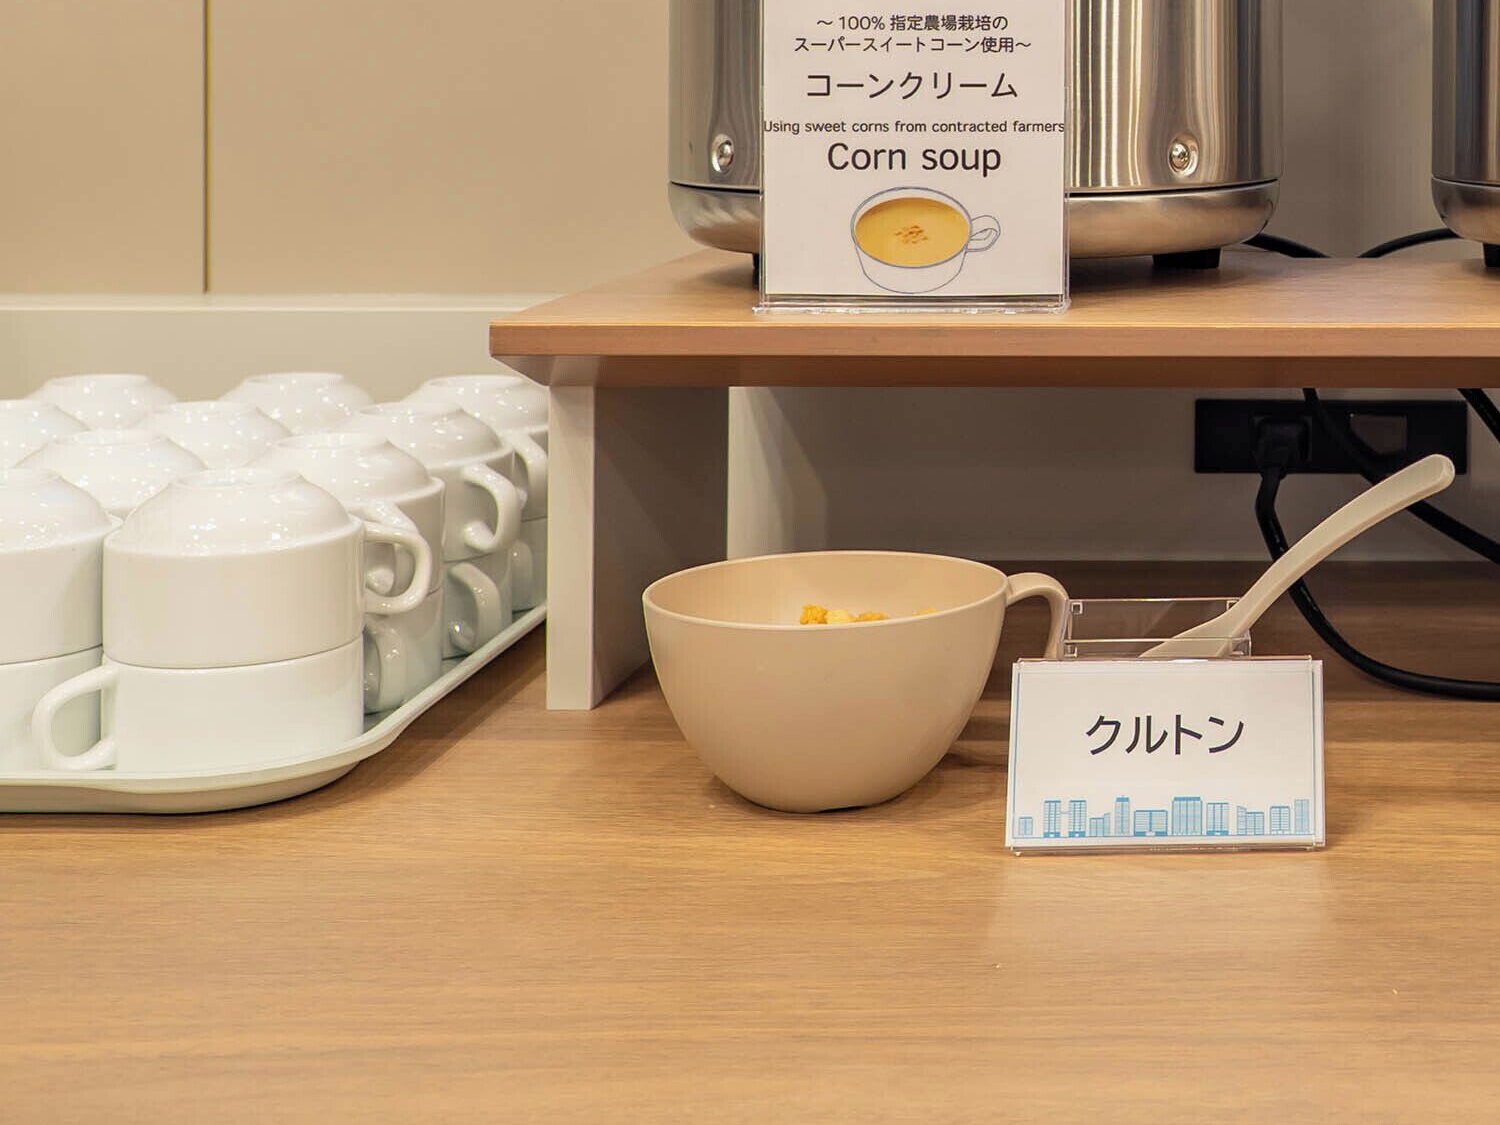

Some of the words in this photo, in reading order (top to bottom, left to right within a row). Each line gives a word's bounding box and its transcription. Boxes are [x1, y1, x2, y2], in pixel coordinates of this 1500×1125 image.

[838, 15, 886, 31] 100%
[889, 14, 1009, 31] 指定農場栽培の
[805, 72, 1019, 100] コーンクリーム
[764, 120, 800, 134] Using
[804, 121, 847, 133] sweet
[852, 123, 890, 133] corns
[894, 120, 926, 133] from
[931, 120, 1008, 133] contracted
[1012, 120, 1065, 133] farmers
[827, 142, 908, 171] Corn
[921, 147, 1002, 178] soup
[1085, 714, 1245, 756] クルトン
